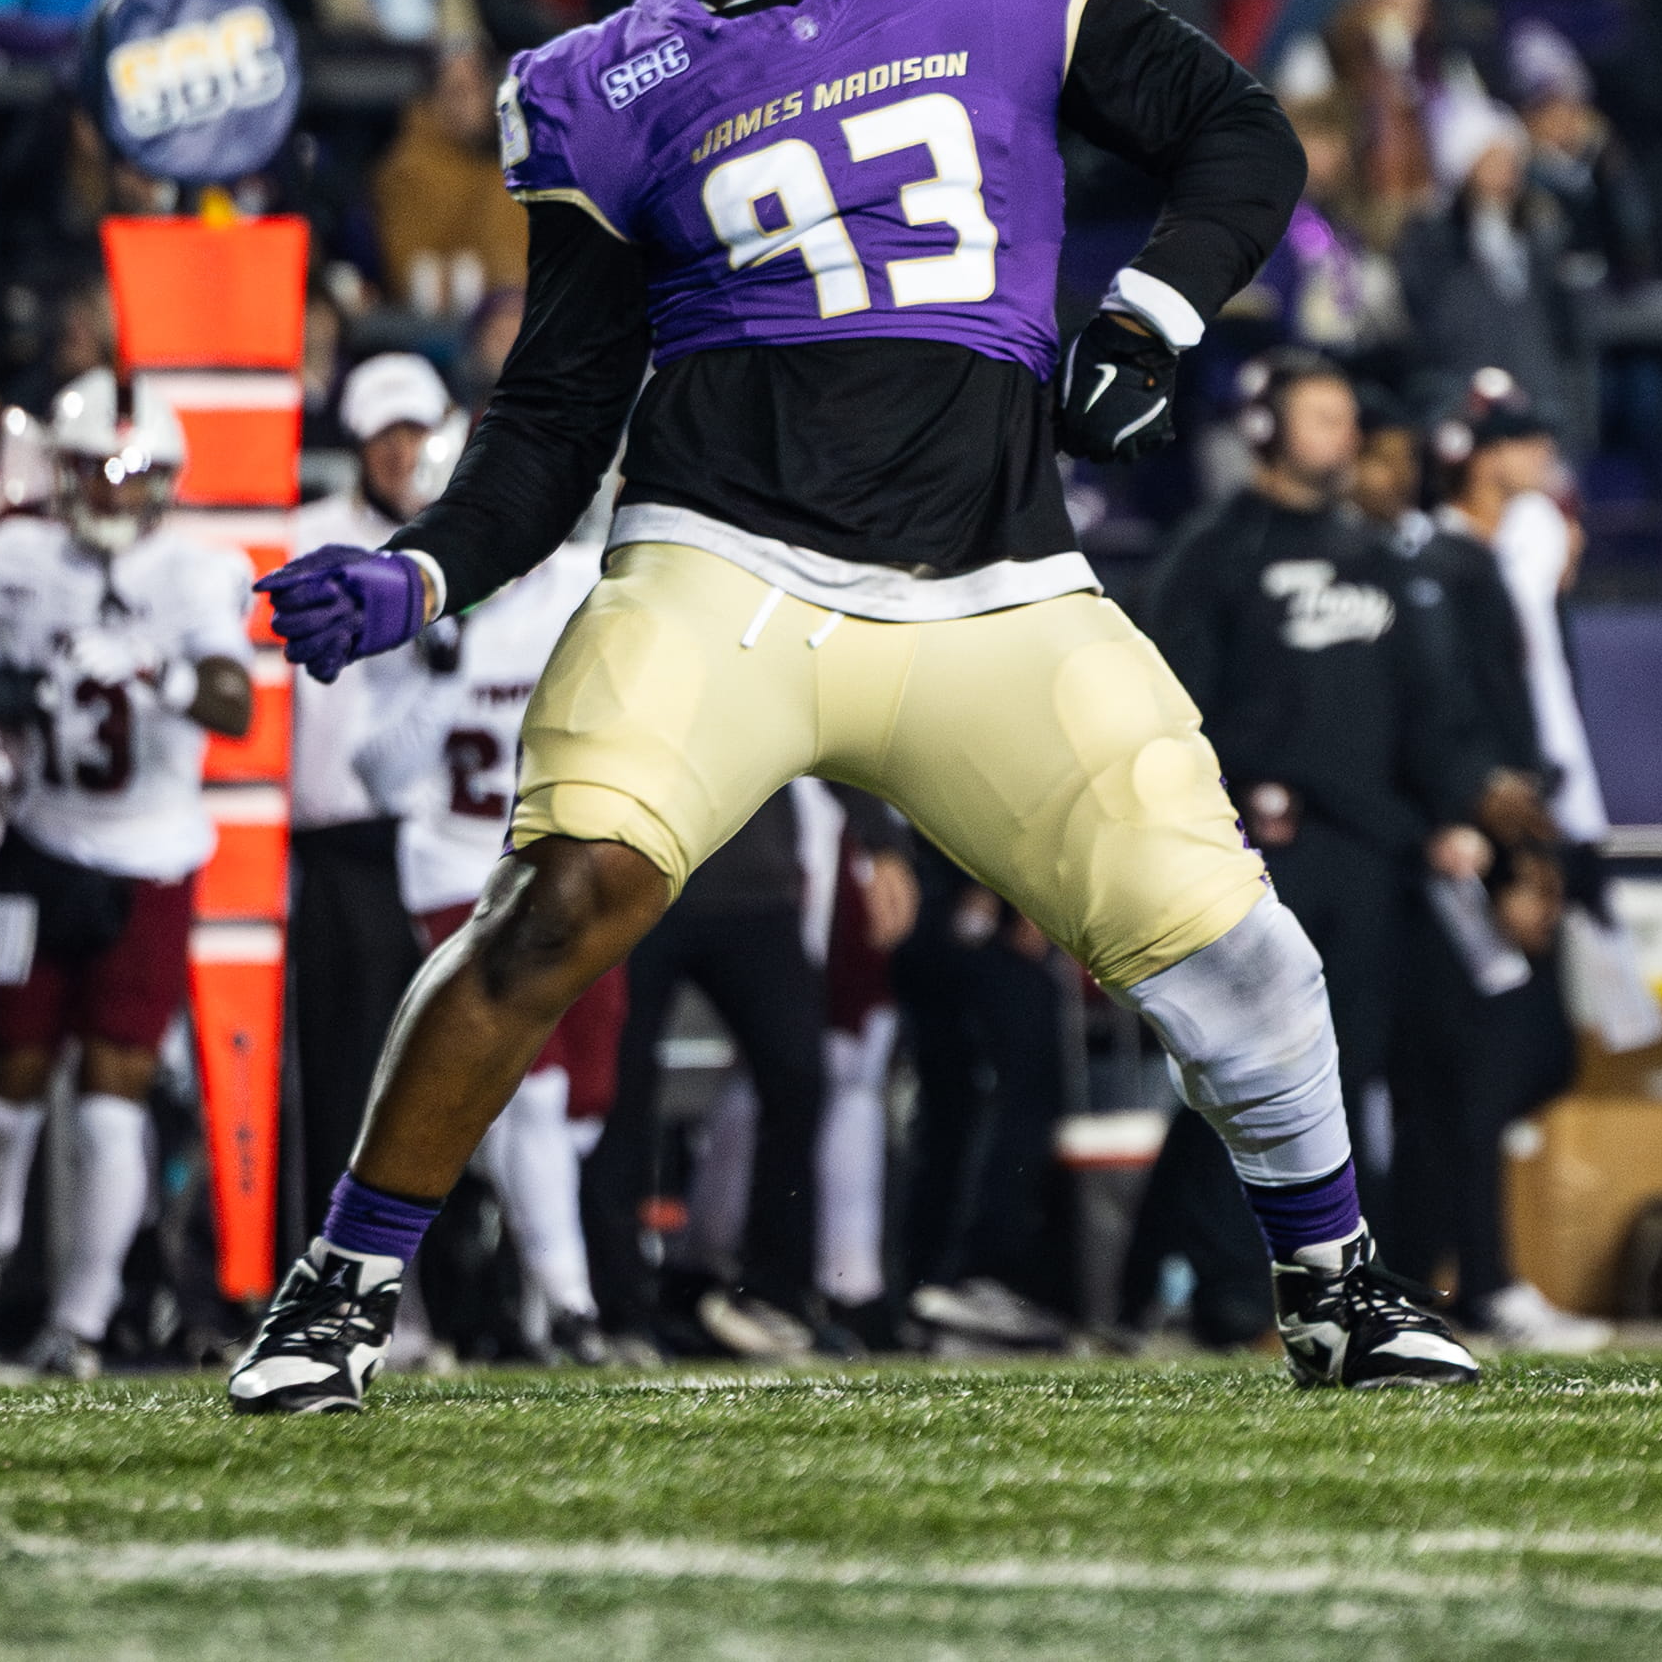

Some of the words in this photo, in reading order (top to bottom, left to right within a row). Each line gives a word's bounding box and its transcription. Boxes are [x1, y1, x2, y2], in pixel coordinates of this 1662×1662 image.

[600, 33, 691, 111] SBC
[691, 90, 804, 164] JAMES
[813, 51, 968, 111] MADISON
[702, 93, 998, 318] 93
[1261, 559, 1396, 652] Troy
[38, 674, 134, 794] 13
